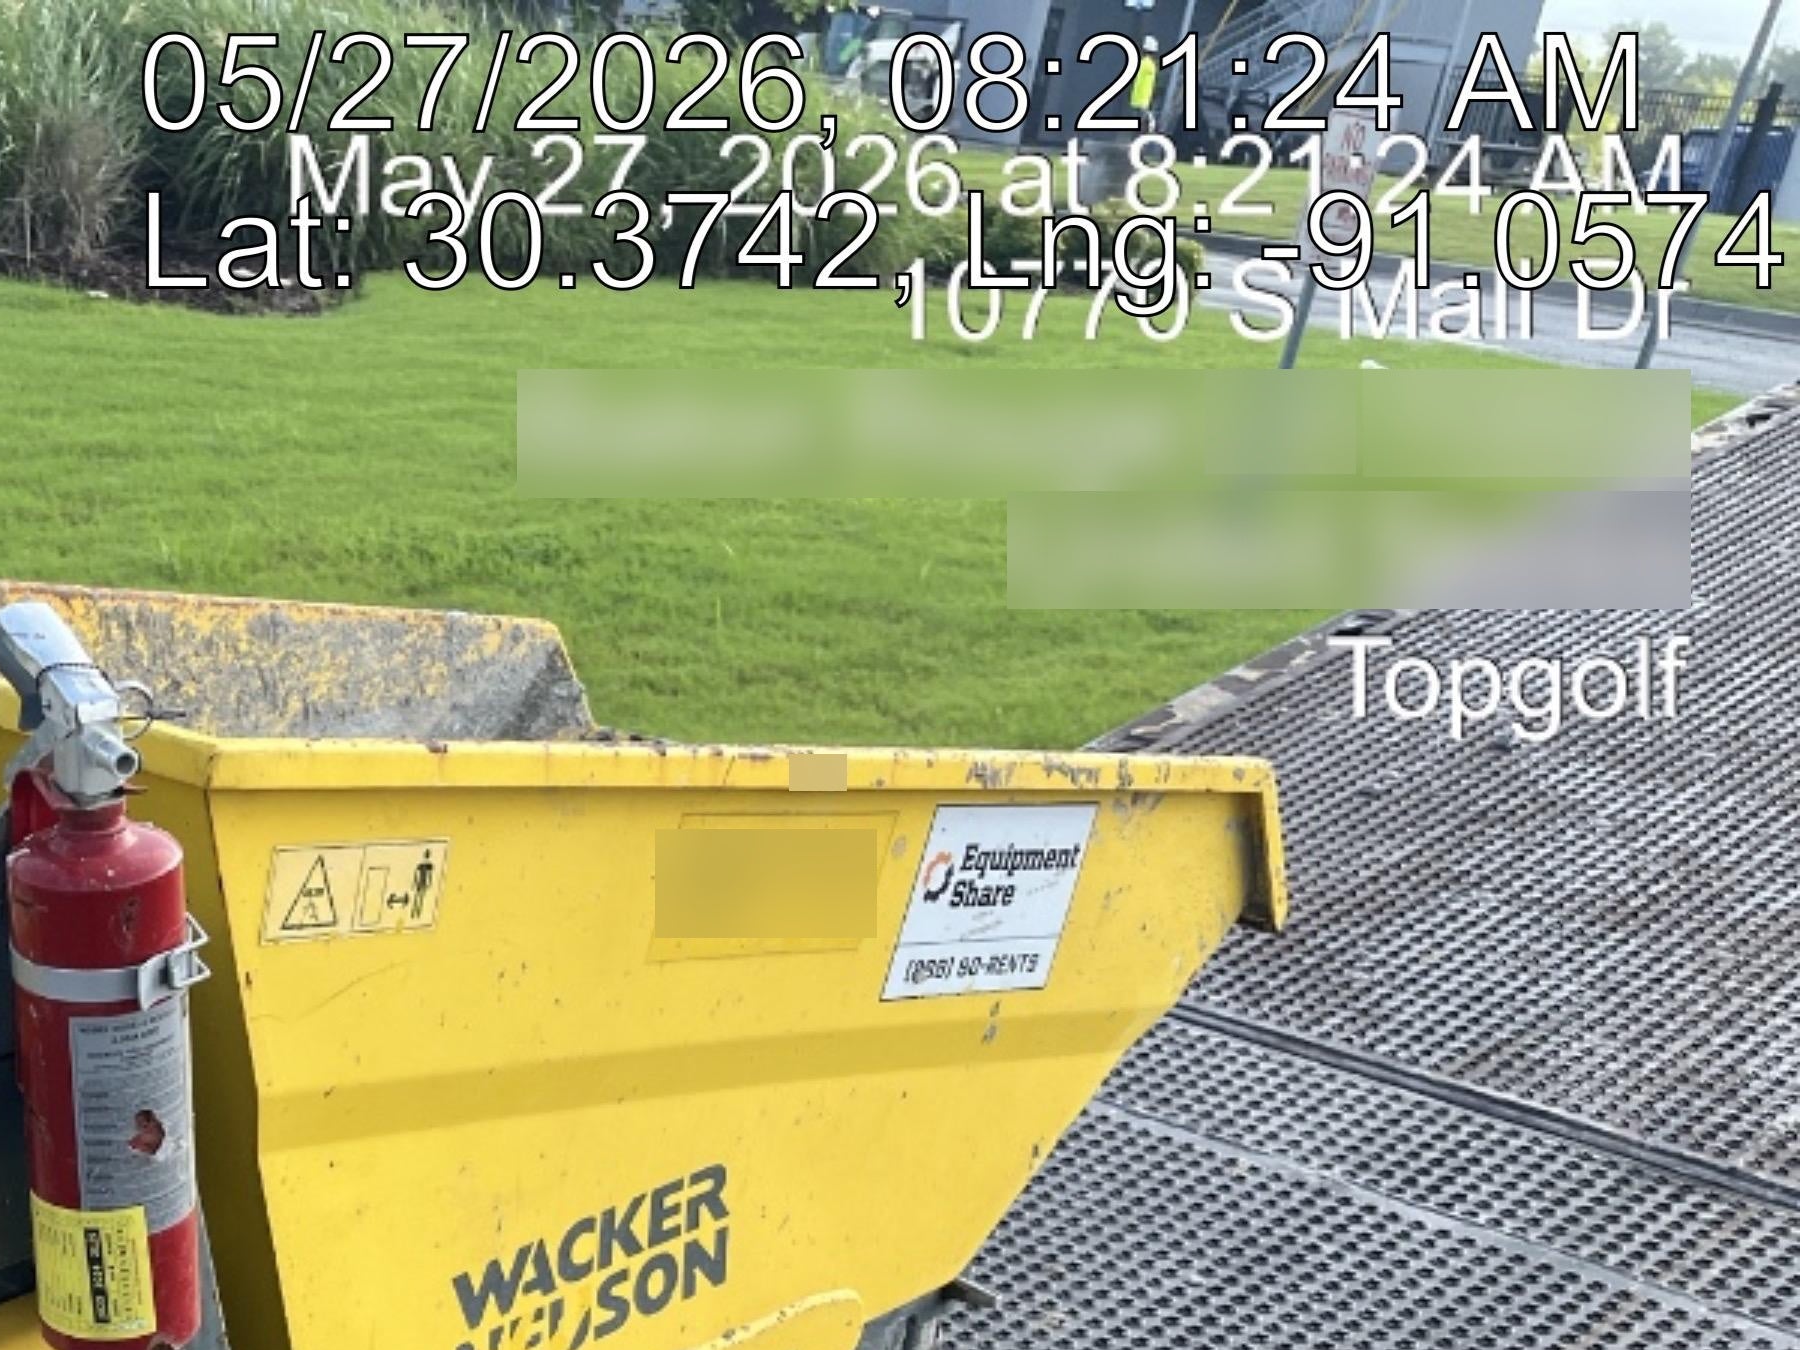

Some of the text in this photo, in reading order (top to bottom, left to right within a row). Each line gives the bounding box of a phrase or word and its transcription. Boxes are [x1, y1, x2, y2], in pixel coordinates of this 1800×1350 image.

[959, 841, 1081, 879] Equipment
[949, 878, 1015, 908] Share
[452, 1163, 730, 1330] WACKER
